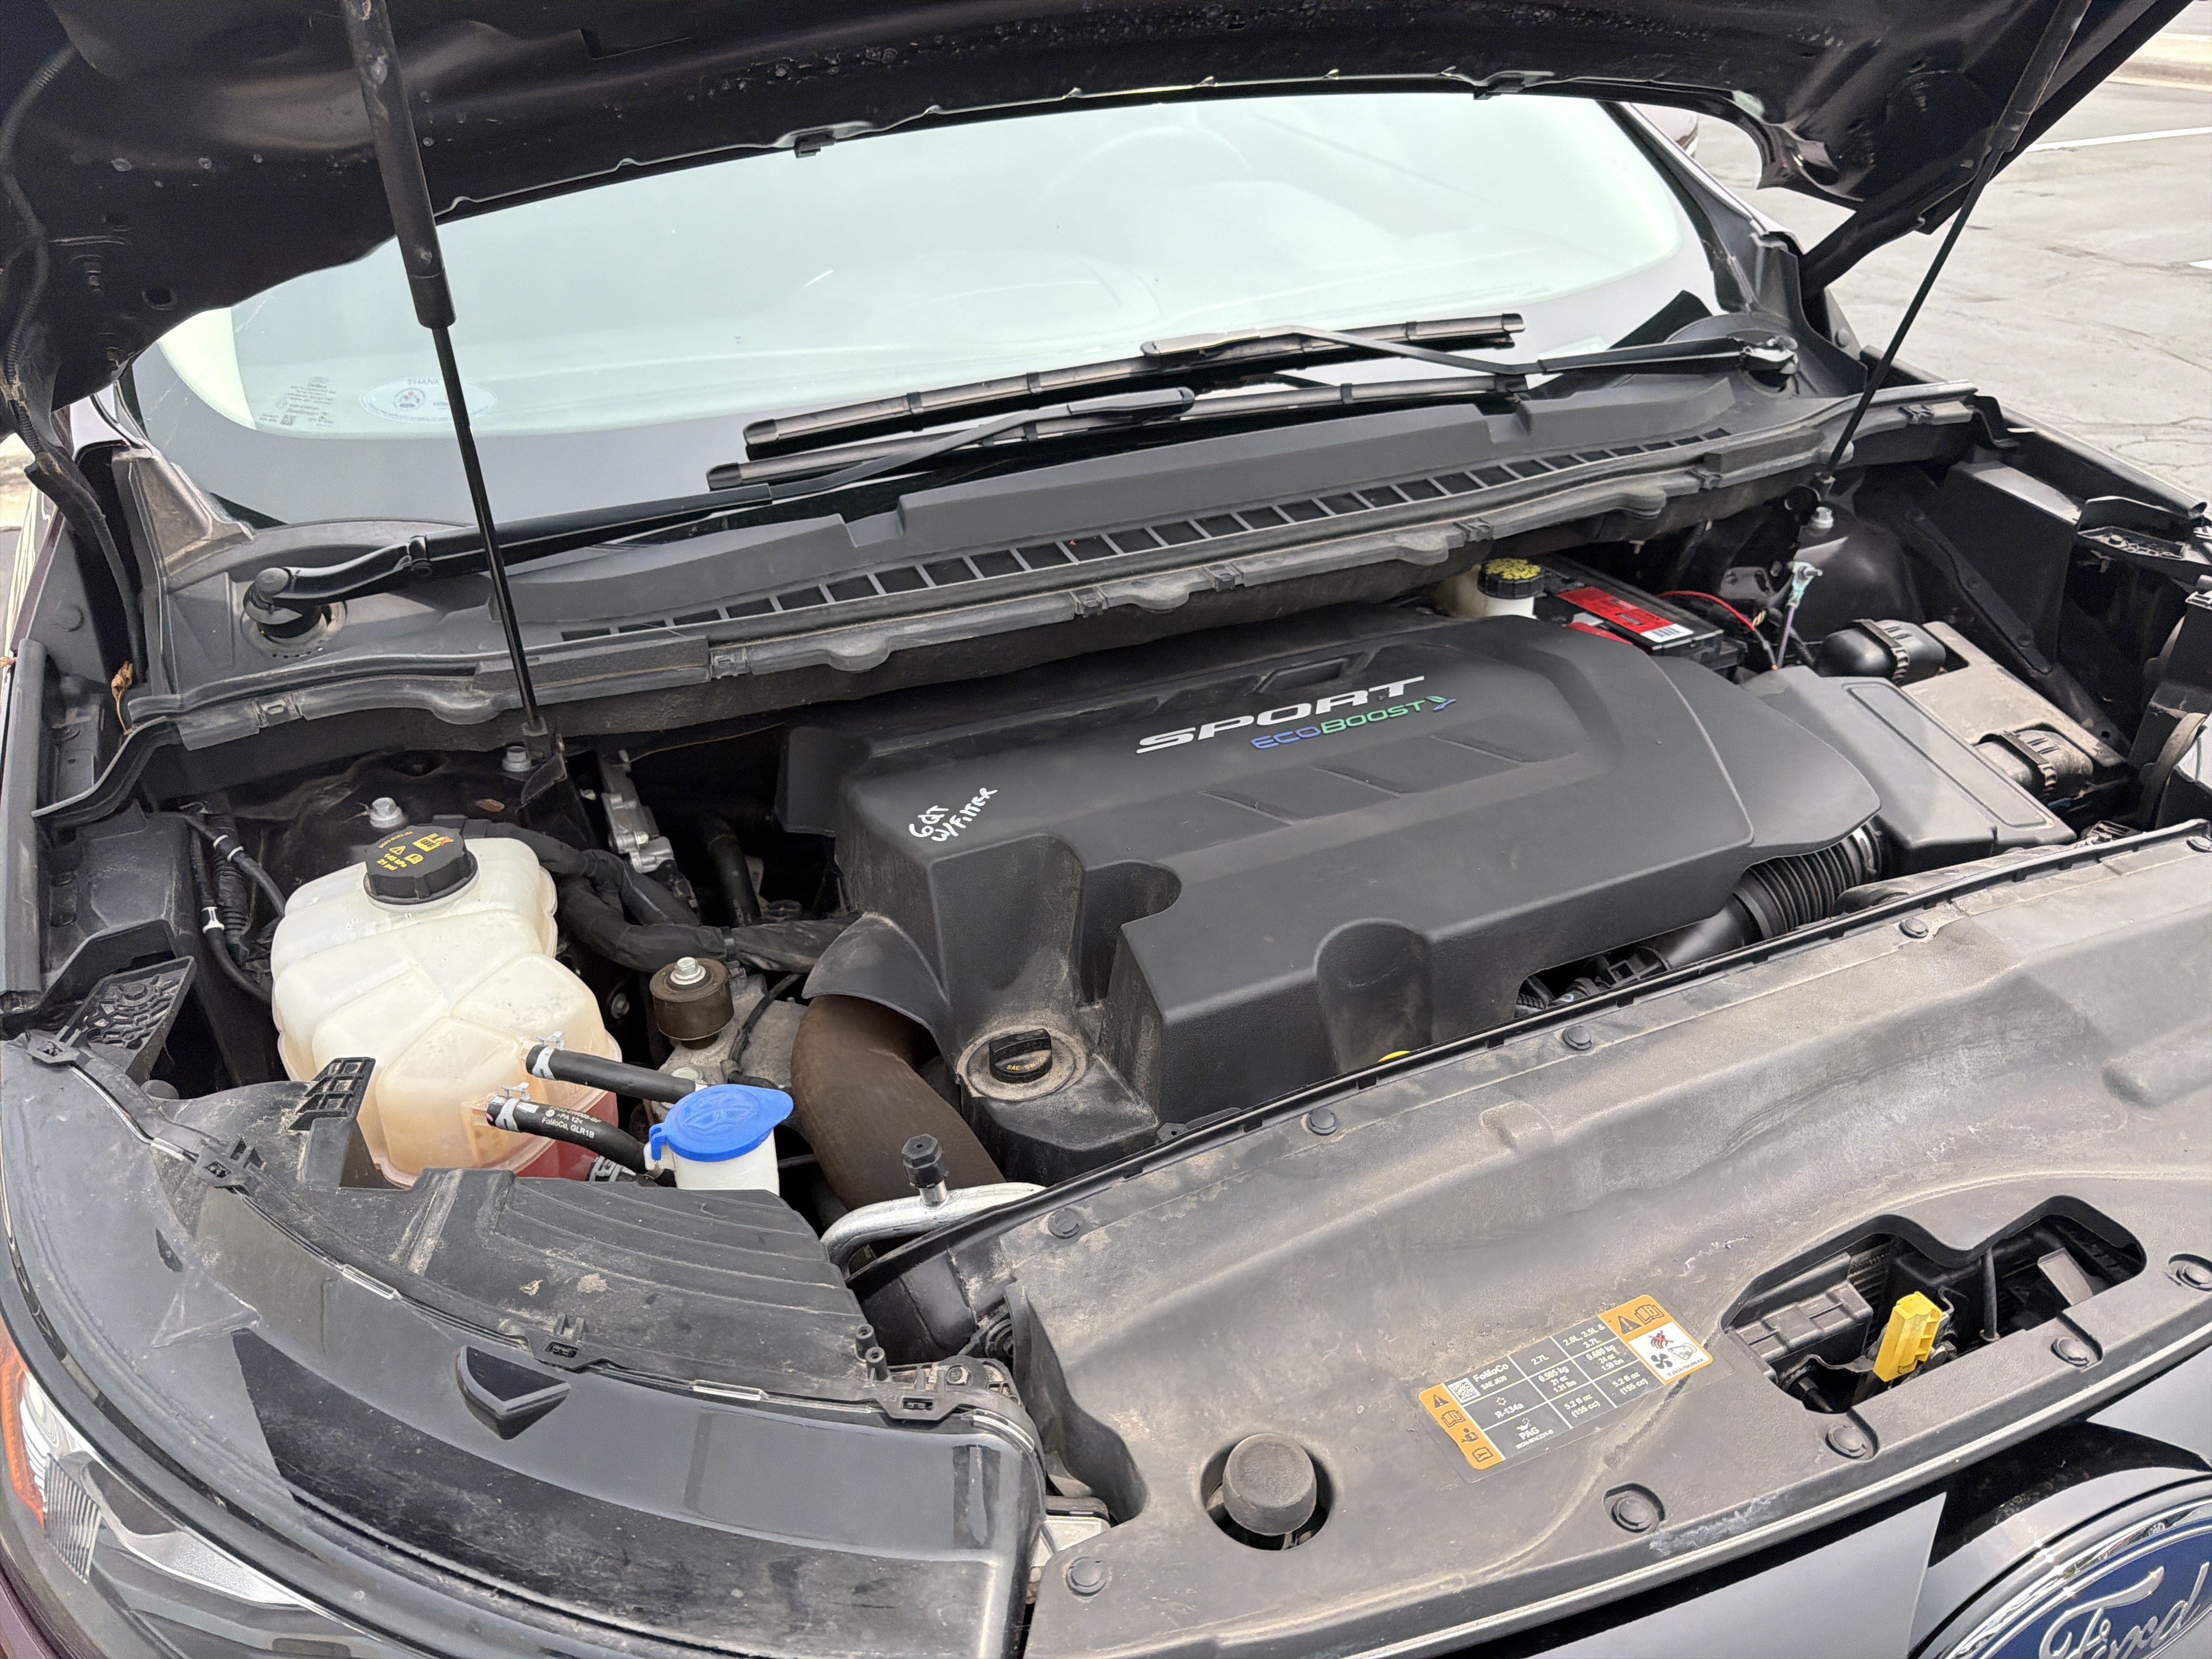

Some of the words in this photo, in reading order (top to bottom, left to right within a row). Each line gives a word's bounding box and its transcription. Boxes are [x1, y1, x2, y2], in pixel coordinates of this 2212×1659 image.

[1136, 675, 1425, 754] SPORT
[1251, 699, 1426, 750] ECOBOOST
[571, 1125, 595, 1139] GLR1B
[1562, 1335, 1583, 1346] 2.0L,
[1581, 1327, 1599, 1338] 3.5L
[1583, 1338, 1601, 1348] 3.7L
[1531, 1354, 1550, 1365] 2.7L
[1585, 1347, 1606, 1361] 0.680
[1472, 1364, 1509, 1382] FoMoCo
[1601, 1362, 1615, 1371] 1.50
[1538, 1369, 1559, 1383] 0.595
[1556, 1365, 1570, 1374] kg
[1480, 1380, 1493, 1390] SAE
[1550, 1378, 1560, 1386] 21
[1553, 1384, 1566, 1393] 1.31
[1612, 1379, 1625, 1387] 5.2
[1620, 1383, 1637, 1395] (155
[1635, 1378, 1649, 1387] cc)
[1494, 1403, 1524, 1419] R-134a
[1564, 1401, 1577, 1410] 5.2
[1571, 1406, 1588, 1418] (155
[1587, 1400, 1601, 1409] cc)
[1519, 1426, 1540, 1440] PAG
[2039, 1561, 2210, 1659] Ford
